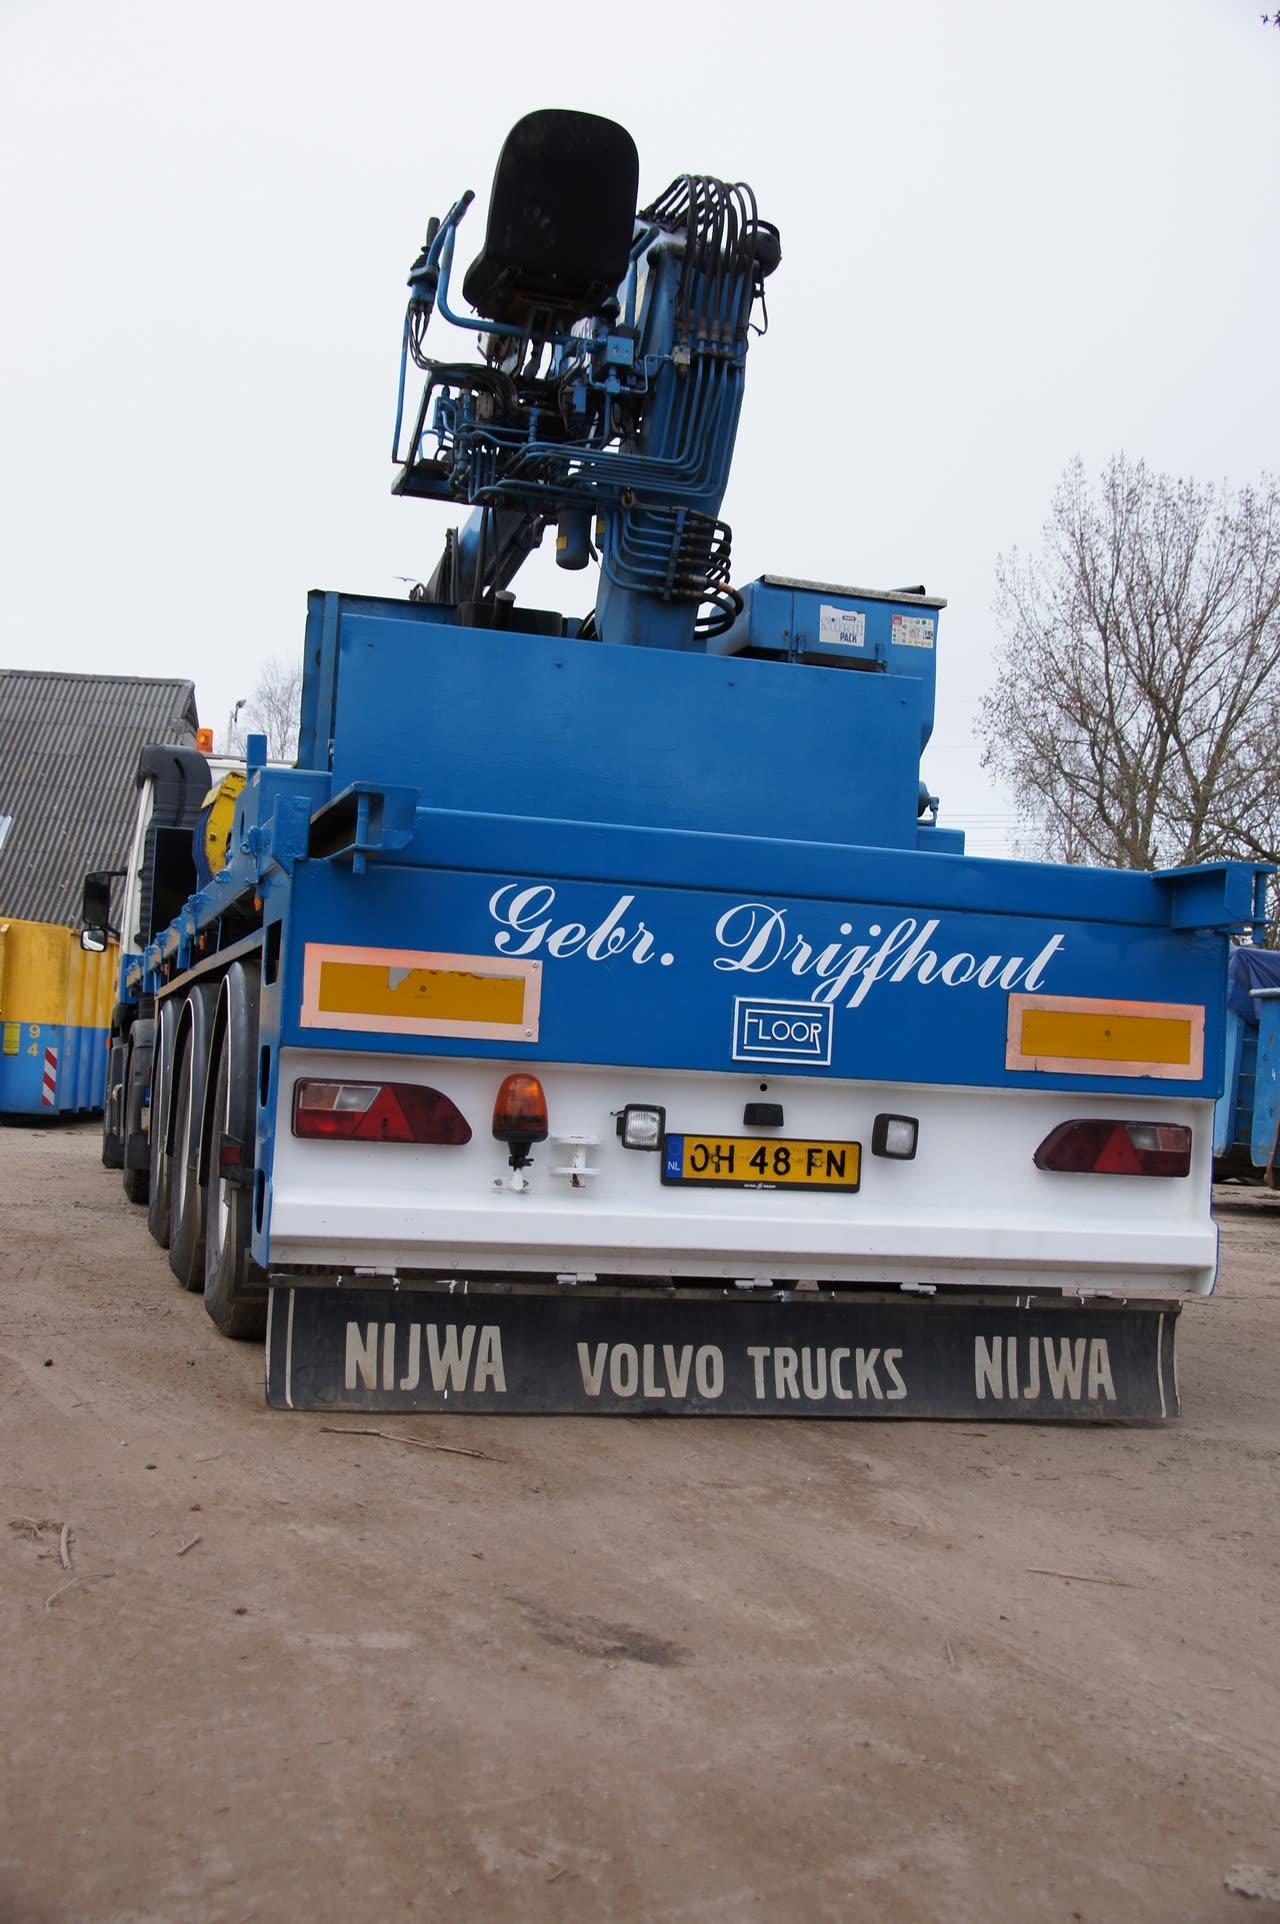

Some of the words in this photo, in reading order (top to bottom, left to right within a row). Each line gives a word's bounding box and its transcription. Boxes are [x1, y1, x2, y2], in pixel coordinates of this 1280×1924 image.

[840, 632, 857, 643] PACK
[489, 883, 674, 966] Gebr.
[713, 902, 1064, 1008] Drijfhout
[29, 1024, 40, 1039] 9
[743, 1008, 823, 1054] FLOOR
[27, 1042, 39, 1056] 4
[667, 1161, 681, 1171] NL
[690, 1143, 735, 1173] OH
[749, 1146, 791, 1176] 48
[806, 1148, 846, 1177] FN
[345, 1321, 507, 1392] NIJWA
[577, 1342, 724, 1398] VOLVO
[747, 1346, 907, 1400] TRUCKS
[975, 1335, 1117, 1400] NIJWA
